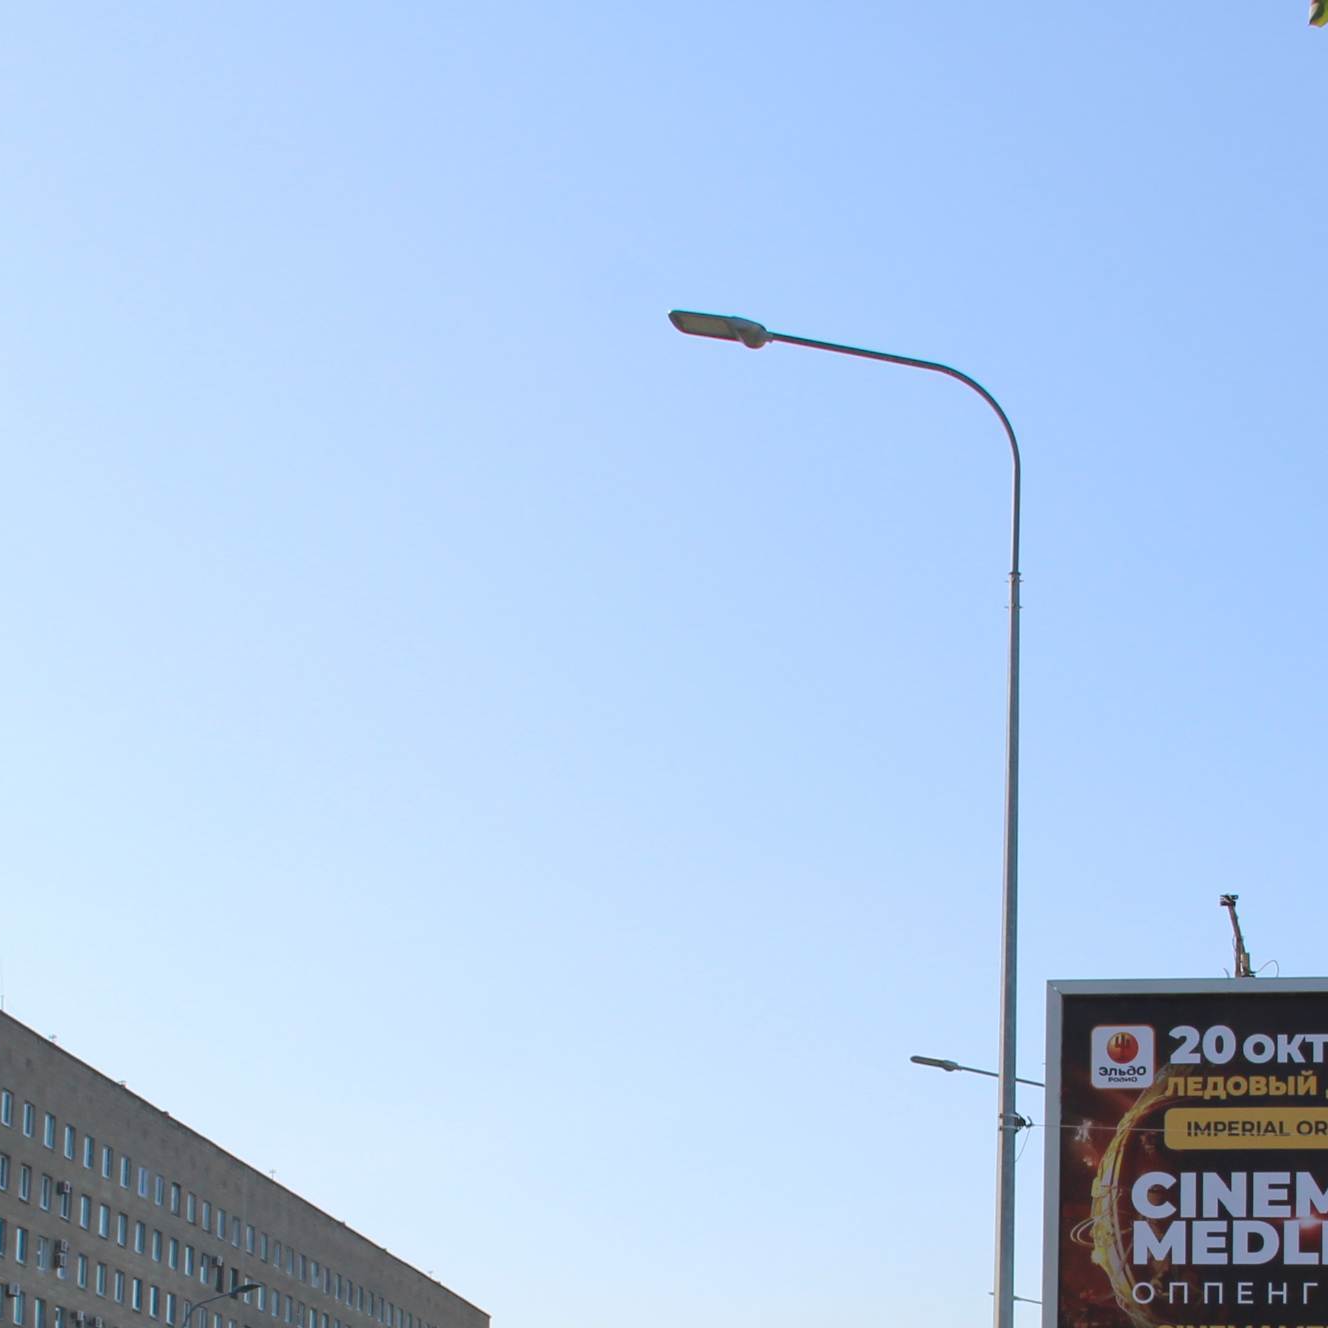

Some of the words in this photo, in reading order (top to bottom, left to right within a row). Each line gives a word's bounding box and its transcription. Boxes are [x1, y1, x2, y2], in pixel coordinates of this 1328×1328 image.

[1168, 1025, 1236, 1065] 20
[1166, 1071, 1317, 1099] ЛЕДОВЫЙ
[1187, 1120, 1290, 1137] IMPERIAL
